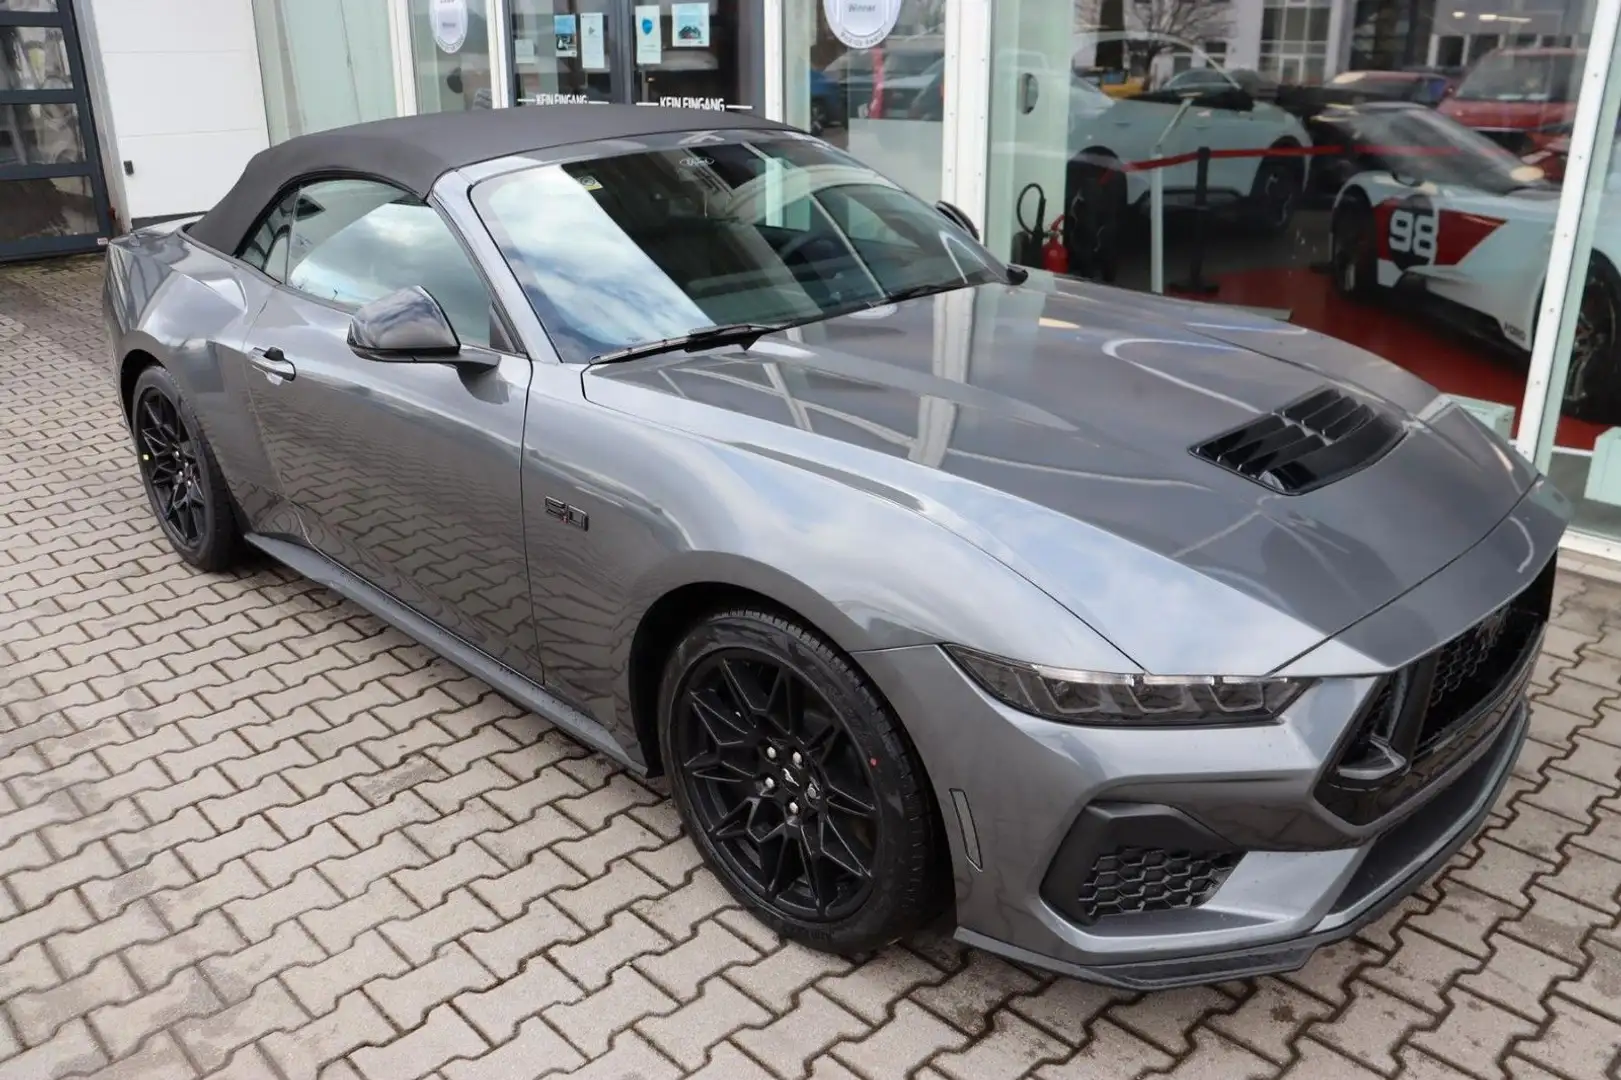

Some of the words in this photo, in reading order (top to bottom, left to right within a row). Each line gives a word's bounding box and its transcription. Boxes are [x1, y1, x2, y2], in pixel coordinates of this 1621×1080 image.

[536, 94, 553, 105] KEIN
[660, 96, 681, 108] KEIN
[682, 97, 725, 112] EINGANG
[1388, 209, 1437, 258] 98
[545, 496, 589, 532] 5.0
